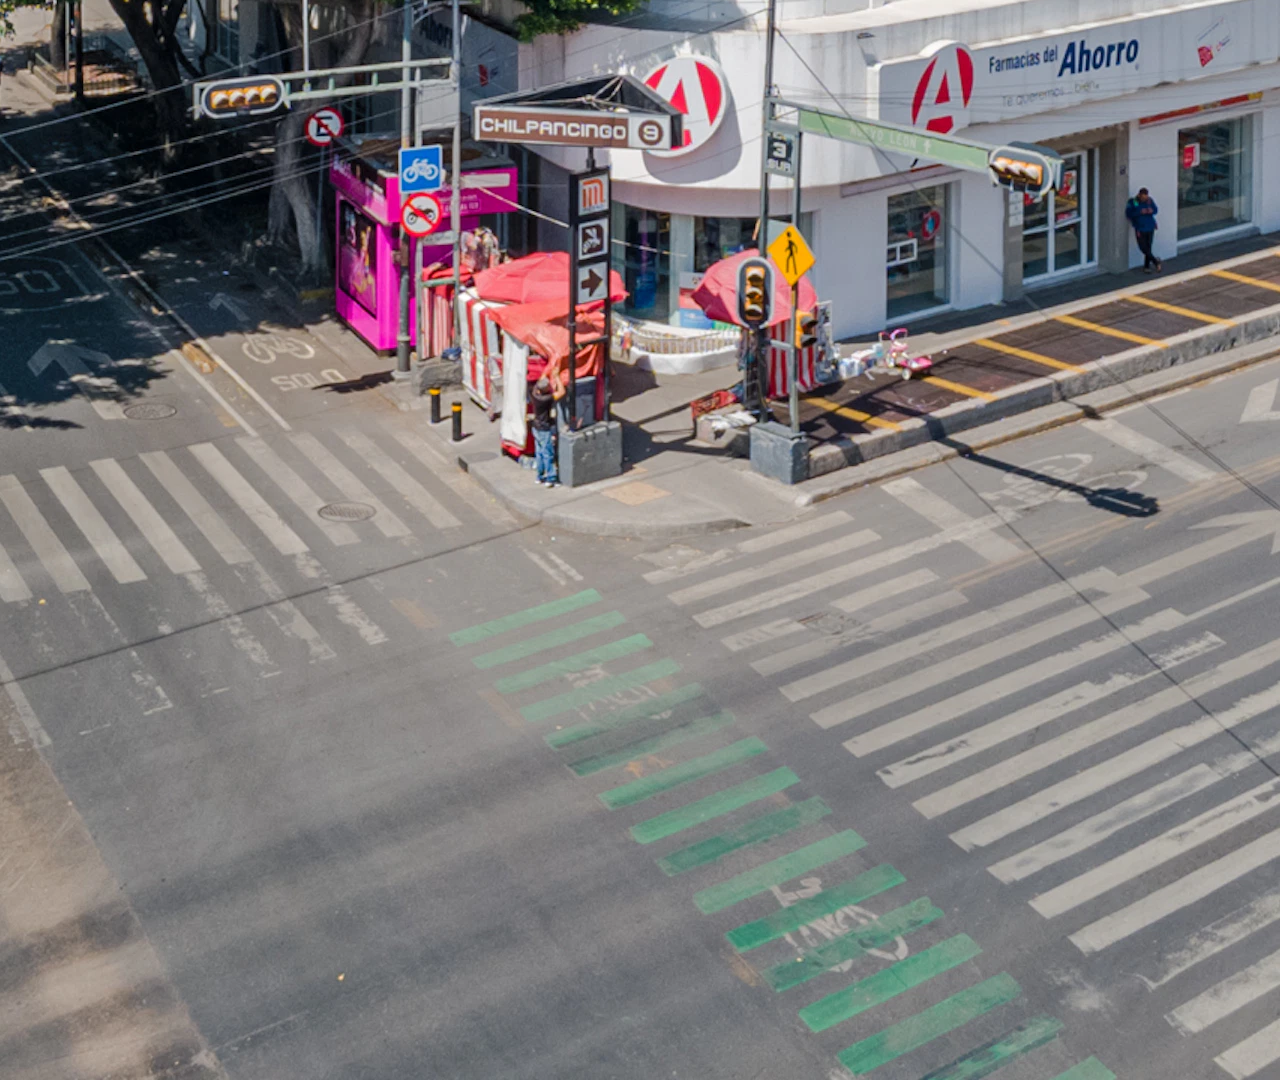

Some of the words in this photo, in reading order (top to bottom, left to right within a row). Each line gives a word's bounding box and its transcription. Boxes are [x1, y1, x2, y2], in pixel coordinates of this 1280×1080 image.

[989, 50, 1040, 74] Farmacias
[1043, 44, 1058, 62] del
[1057, 39, 1139, 77] Ahorro
[480, 117, 626, 140] CHILPANCINGO
[643, 125, 659, 141] 9
[773, 141, 787, 158] 3
